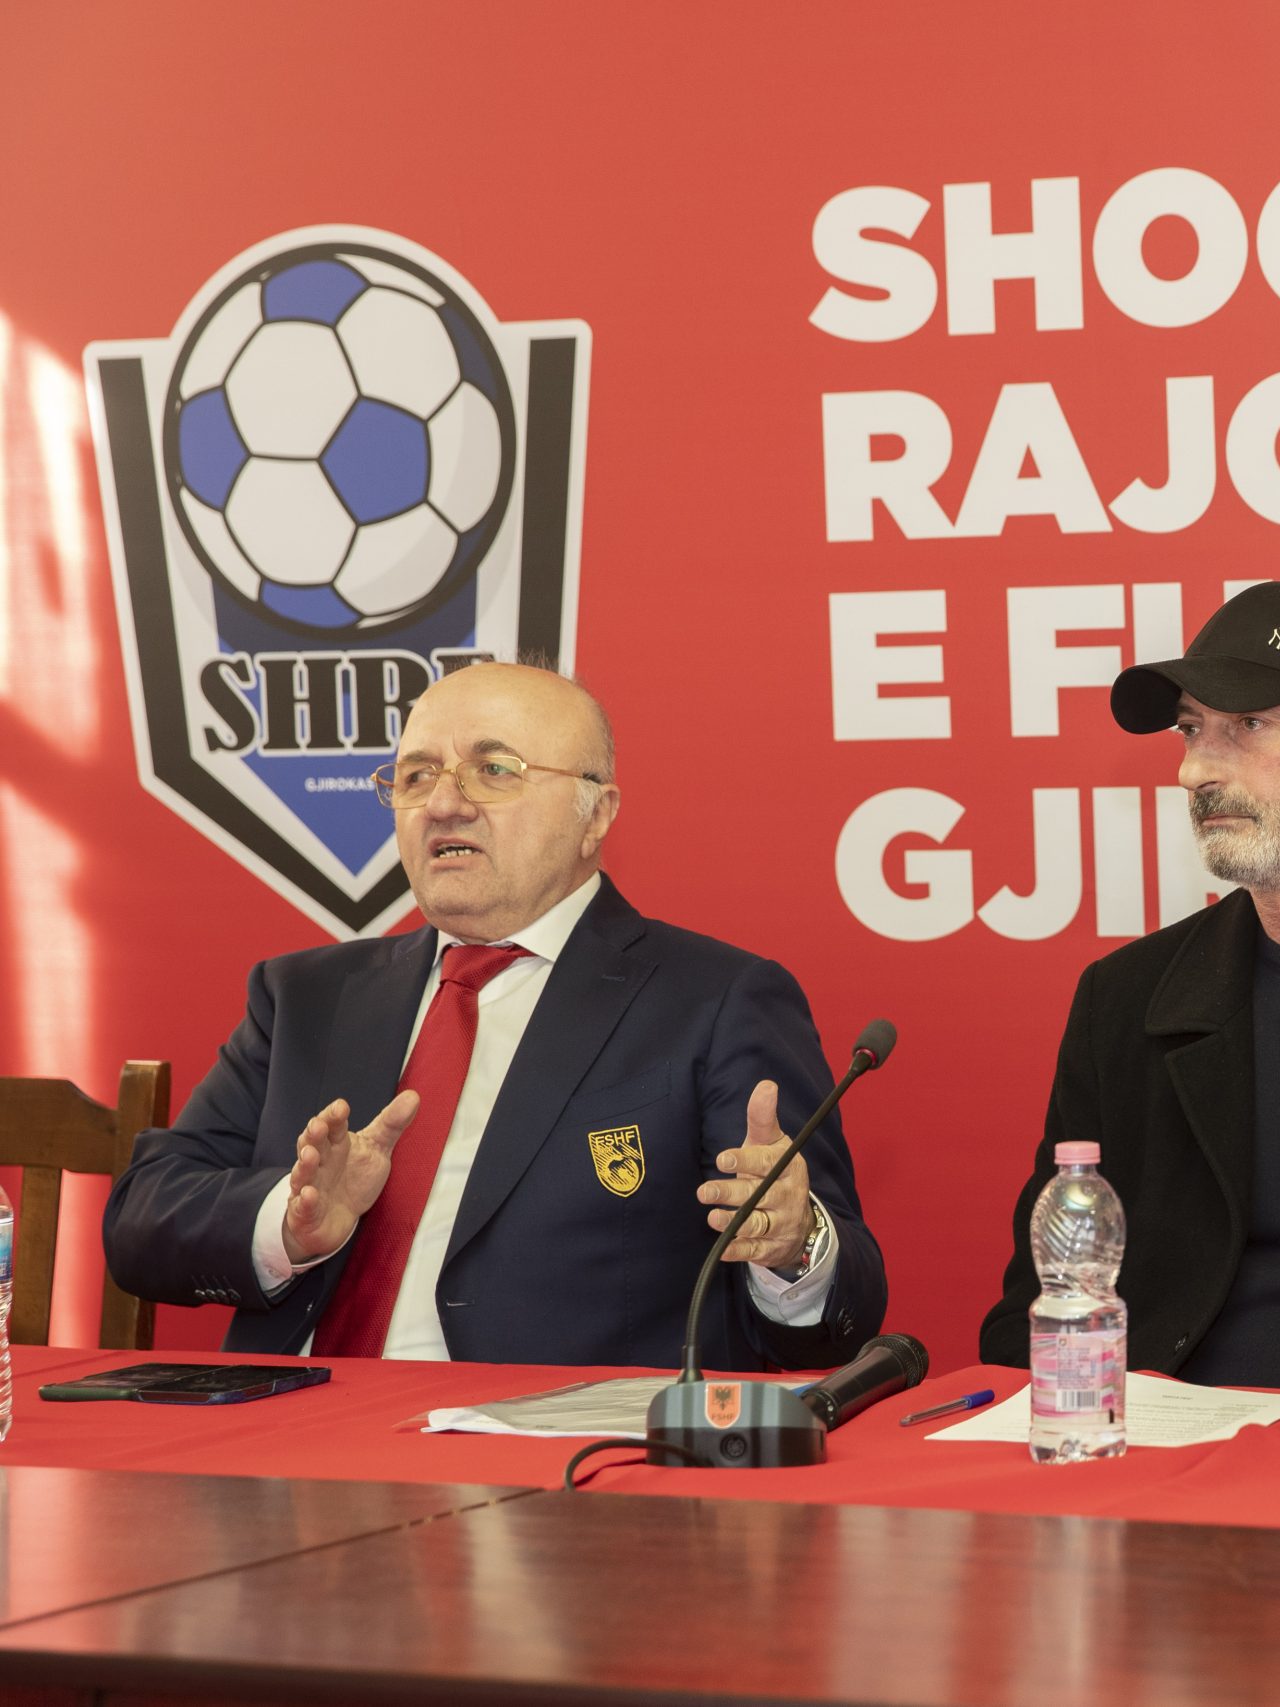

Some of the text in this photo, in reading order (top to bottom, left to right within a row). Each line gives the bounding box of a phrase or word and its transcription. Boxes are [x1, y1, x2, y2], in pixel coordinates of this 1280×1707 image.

[199, 650, 495, 754] SHR
[829, 590, 952, 741] E
[595, 1130, 636, 1147] FSHF
